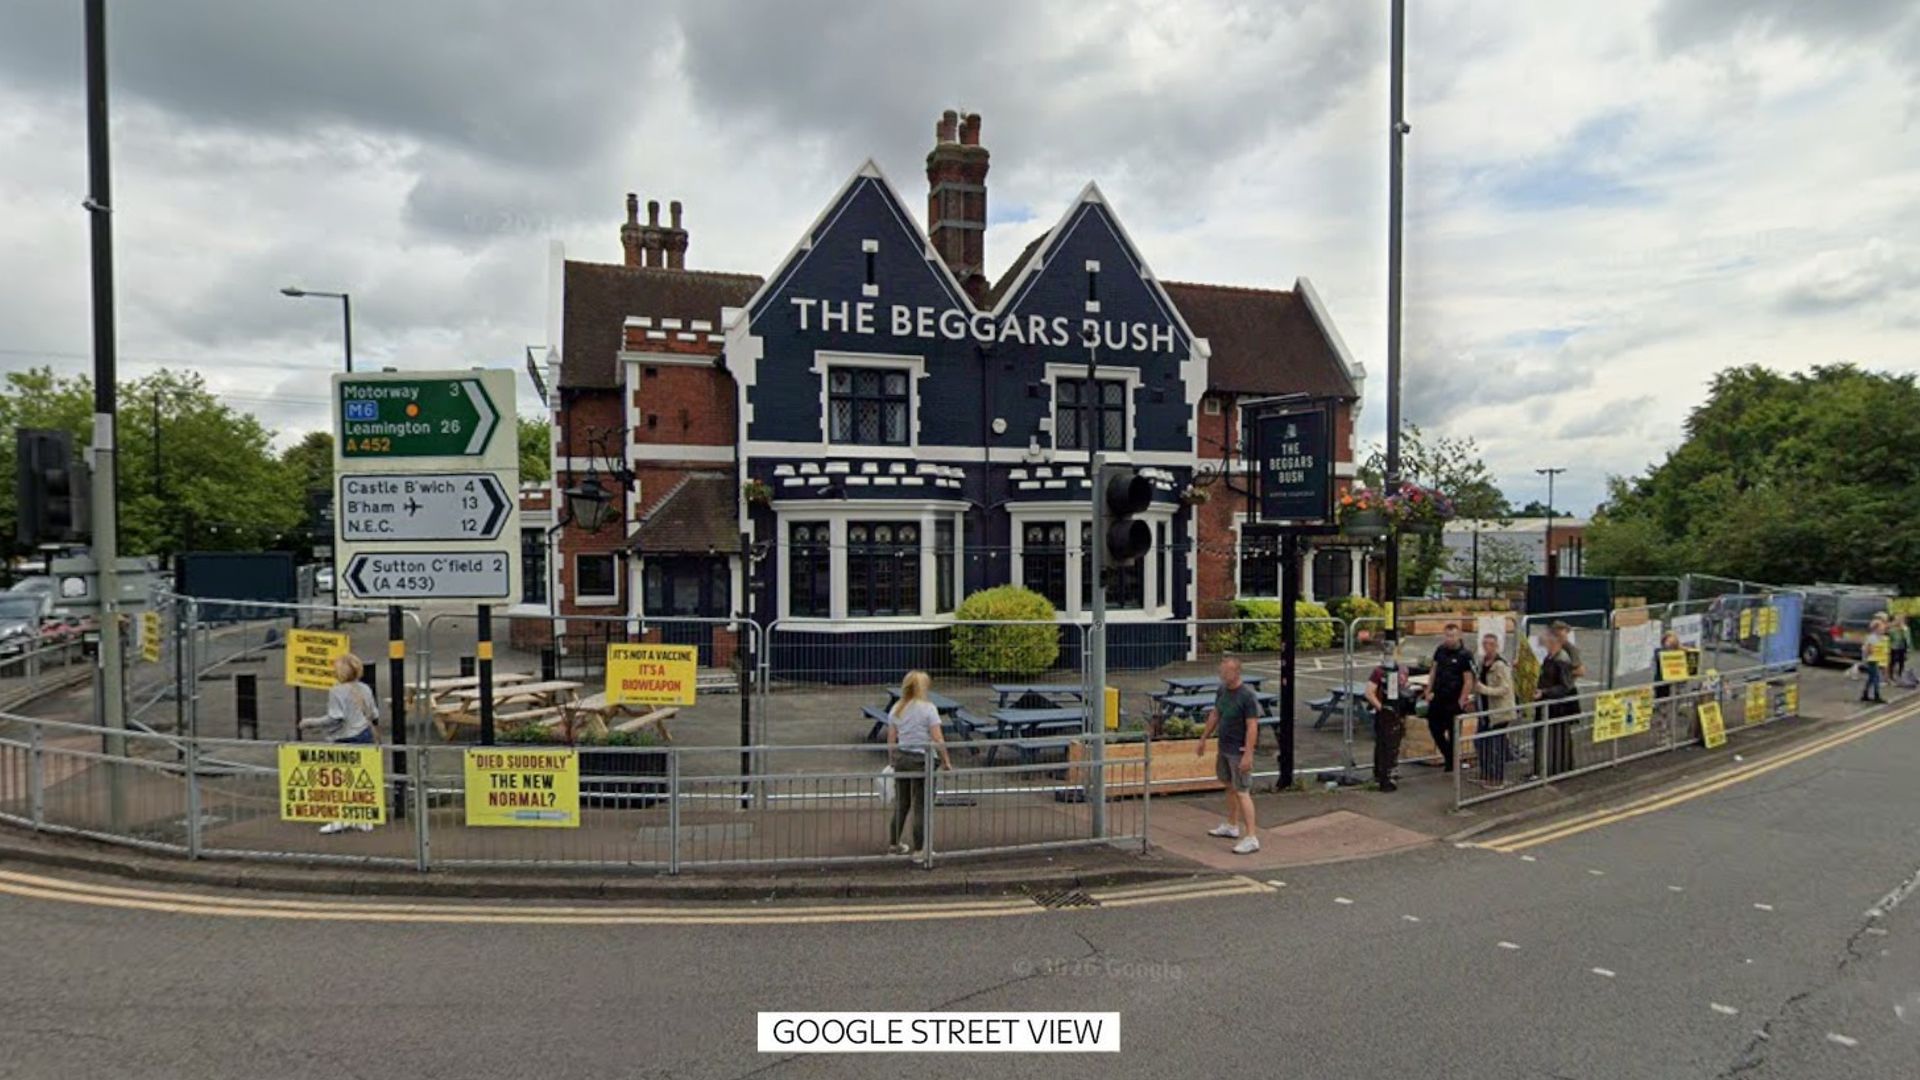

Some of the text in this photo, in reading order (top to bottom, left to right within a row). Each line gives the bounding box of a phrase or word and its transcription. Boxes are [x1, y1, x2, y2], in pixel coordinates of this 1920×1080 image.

[790, 297, 1175, 353] THE BEGGARS BUSH
[344, 383, 459, 400] Motorway 3
[348, 404, 373, 417] M6
[345, 421, 461, 437] Leamington 26
[360, 438, 390, 451] 452
[1281, 442, 1300, 455] THE
[1269, 455, 1313, 471] BEGGARS
[1279, 470, 1304, 483] BUSH
[347, 481, 474, 494] Castle B'wich 4
[348, 497, 478, 513] B'ham 13
[348, 519, 477, 533] N.E.C. 12
[373, 559, 502, 573] Sutton C'field 2
[373, 576, 435, 591] (A 453)
[630, 650, 647, 660] NOT
[648, 650, 655, 660] A
[656, 650, 692, 662] VACCINE
[658, 664, 665, 676] A
[622, 679, 681, 692] BIOWEAPON
[298, 749, 362, 764] WARNING!
[320, 767, 342, 788] 5G
[490, 773, 554, 789] THE NEW
[307, 789, 377, 805] SURVEILLANCE
[489, 791, 556, 807] NORMAL?
[341, 805, 380, 820] SYSTEM
